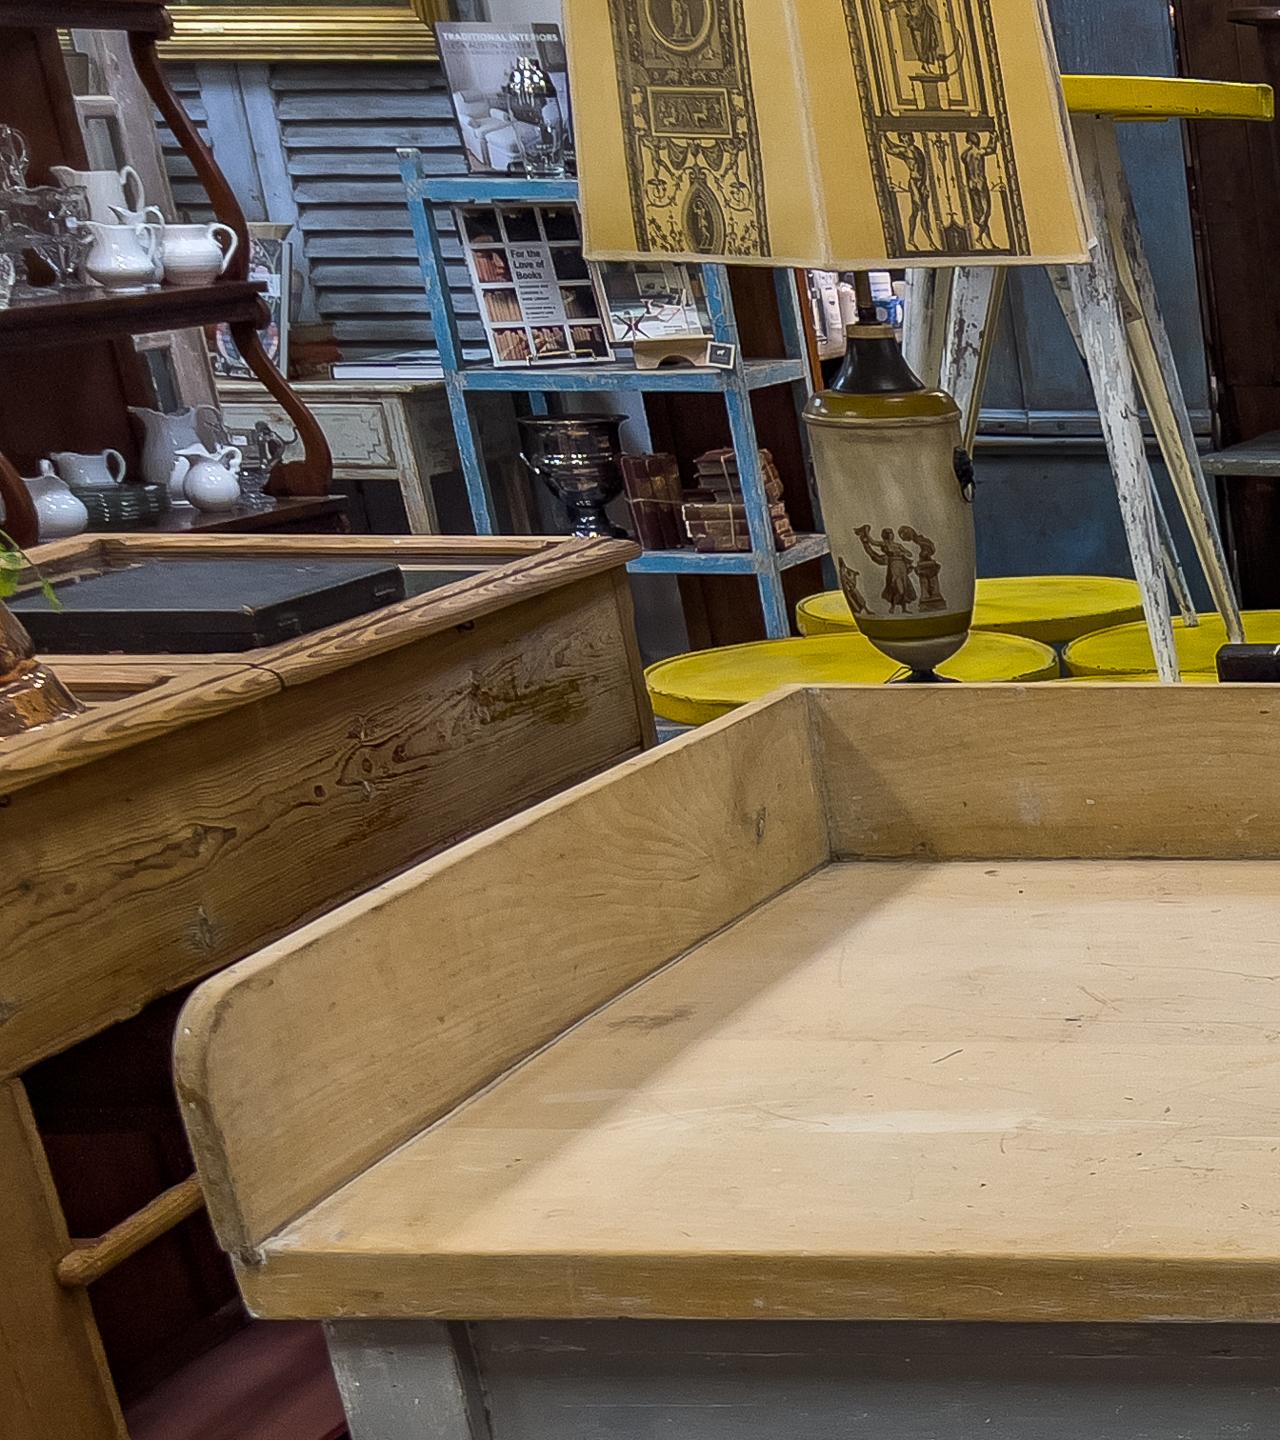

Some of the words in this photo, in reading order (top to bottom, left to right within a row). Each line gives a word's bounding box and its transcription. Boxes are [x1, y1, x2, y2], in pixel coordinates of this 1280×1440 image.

[442, 32, 507, 41] TRADITIONAL
[509, 33, 559, 42] INTERIORS
[510, 249, 525, 258] For
[526, 249, 540, 258] the
[513, 260, 534, 269] Love
[535, 259, 545, 269] of
[516, 271, 543, 280] Books
